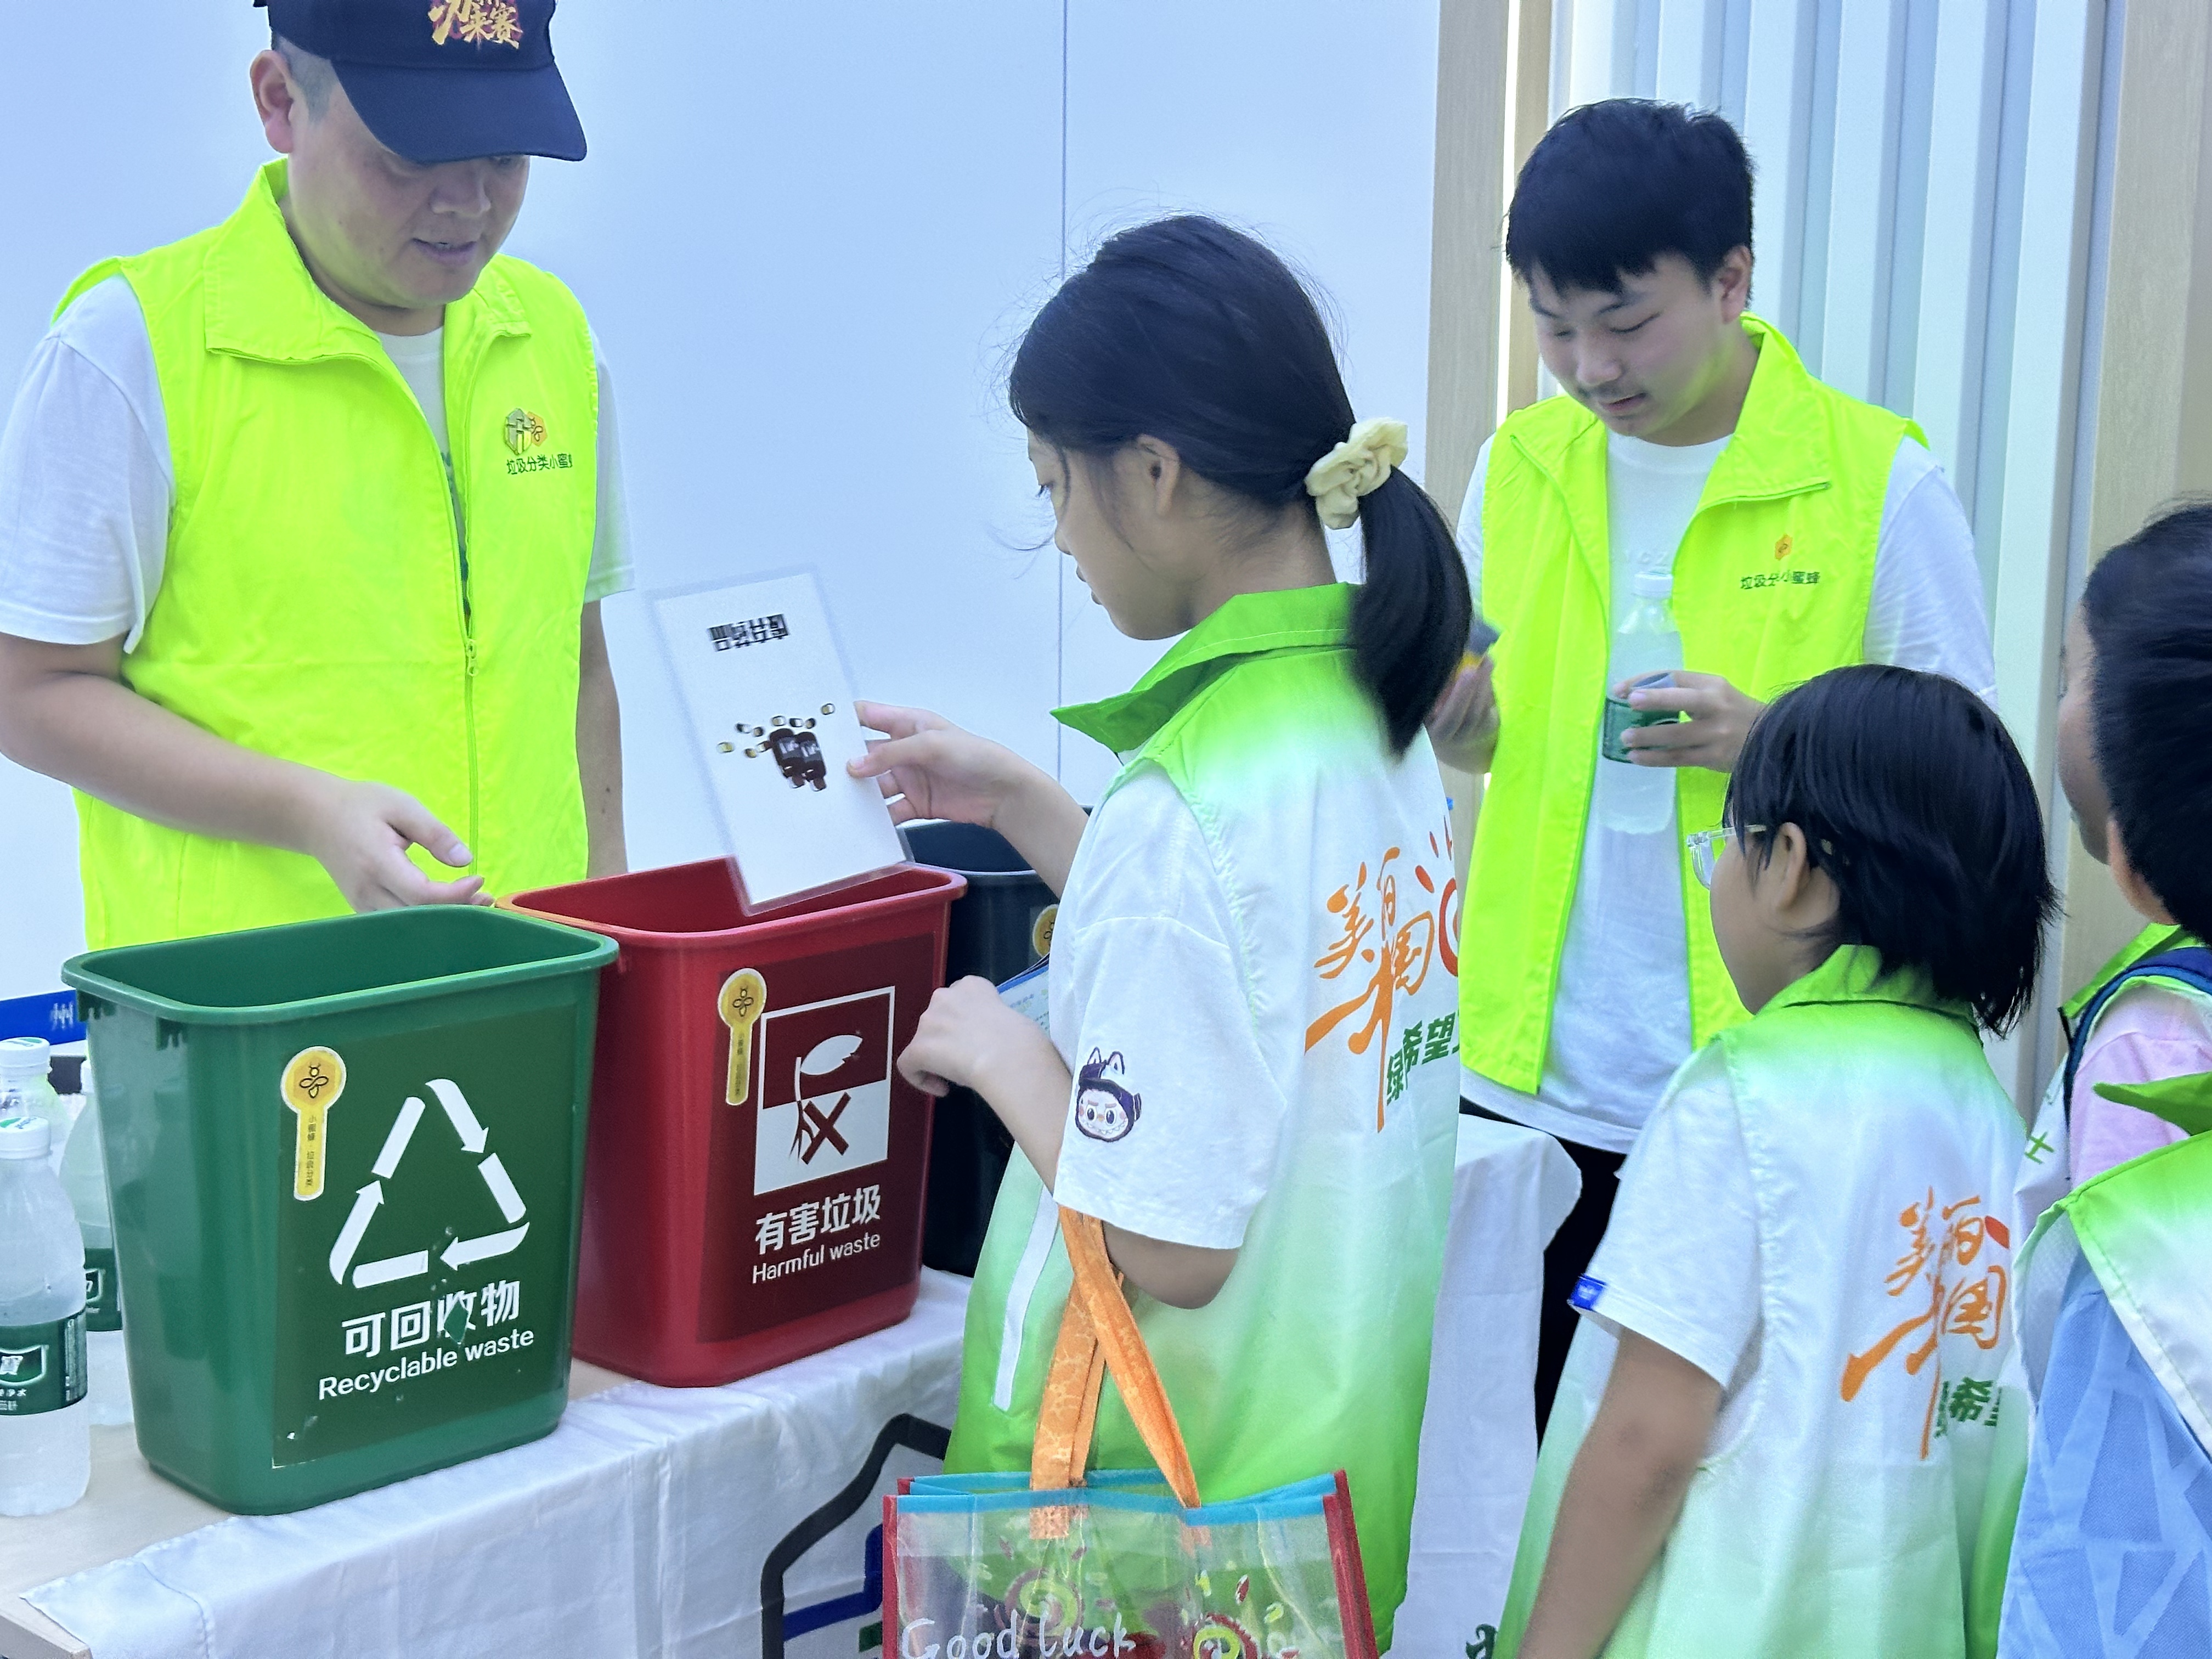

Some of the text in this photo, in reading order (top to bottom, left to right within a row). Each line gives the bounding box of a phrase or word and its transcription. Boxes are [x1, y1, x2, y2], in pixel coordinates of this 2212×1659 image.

[755, 1184, 881, 1255] 有害垃圾
[752, 1232, 881, 1284] Harmful waste
[319, 1328, 534, 1401] Recyclable waste
[901, 1609, 1020, 1659] Good
